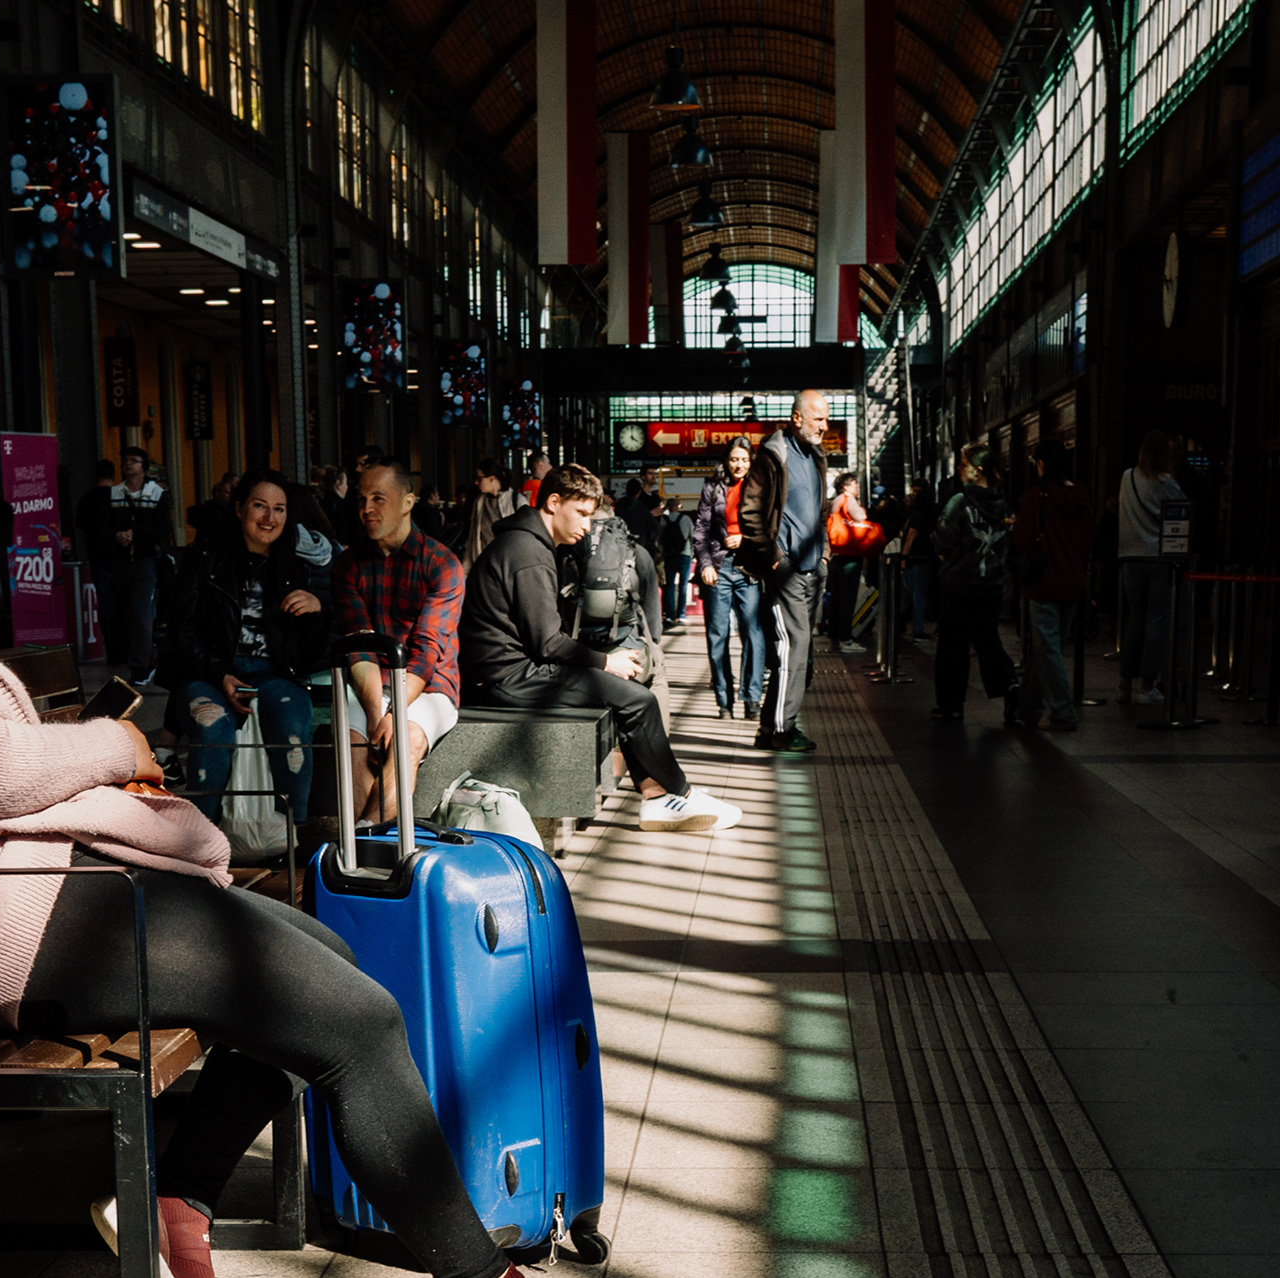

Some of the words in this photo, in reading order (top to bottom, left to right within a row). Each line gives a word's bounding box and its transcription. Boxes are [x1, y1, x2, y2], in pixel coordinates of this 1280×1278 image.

[111, 356, 125, 408] COSTA
[1165, 384, 1217, 400] BIURO
[23, 497, 54, 513] DARMO
[15, 556, 54, 583] 7200
